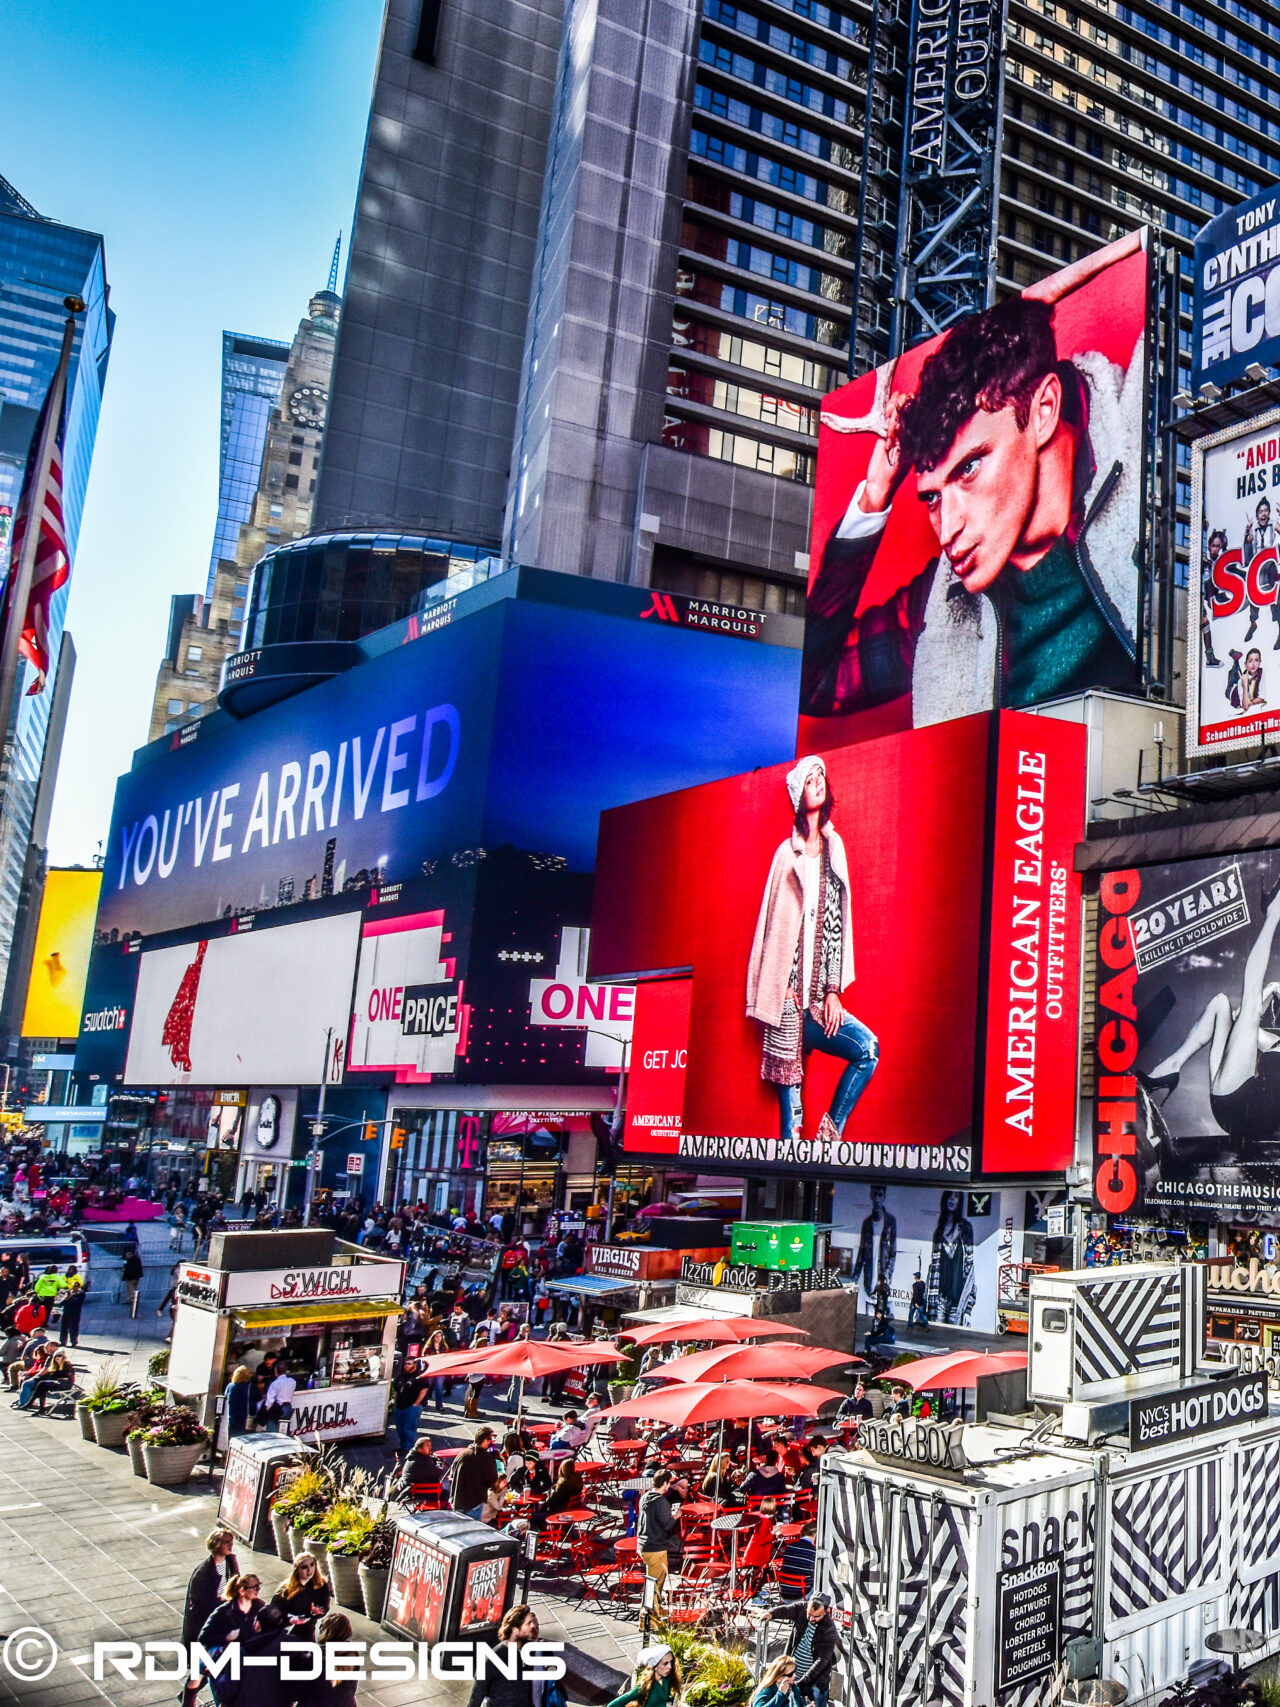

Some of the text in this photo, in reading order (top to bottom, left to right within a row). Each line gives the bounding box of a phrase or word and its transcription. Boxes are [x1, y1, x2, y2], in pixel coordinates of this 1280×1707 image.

[1236, 199, 1277, 236] TONY
[1201, 289, 1232, 371] THE
[1237, 468, 1267, 499] HAS
[423, 599, 457, 621] MARRIOTT
[688, 601, 767, 624] MARRIOTT
[421, 613, 452, 634] MARQUIS
[687, 612, 758, 636] MARQUIS
[230, 651, 262, 667] ARRIOTT
[228, 665, 254, 680] ARQUIS
[118, 703, 461, 890] YOU'VE ARRIVED
[1134, 874, 1238, 945] 20 YEARS
[1005, 751, 1046, 1136] AMERICAN EAGLE
[1046, 864, 1068, 1019] OUTFITTERS
[1177, 937, 1184, 948] IT
[368, 987, 403, 1022] ONE
[403, 996, 457, 1034] PRICE
[541, 984, 635, 1021] ONE
[83, 1005, 119, 1032] swatch
[1096, 869, 1142, 1214] CHICAGO
[644, 1050, 668, 1070] GET
[632, 1115, 673, 1127] AMERICAN
[680, 1135, 970, 1172] AMERICAN EAGLE OUTFITTERS
[591, 1246, 641, 1271] VIRGIL'S
[270, 1281, 361, 1299] Delicatessen
[768, 1267, 842, 1293] DRINK
[1248, 1309, 1276, 1318] PASTRIES
[1139, 1404, 1170, 1426] NYC's
[1171, 1381, 1264, 1432] HOT DOGS
[1140, 1421, 1169, 1440] best
[1001, 1492, 1095, 1570] snack
[470, 1559, 506, 1586] JERSEY
[1001, 1559, 1060, 1588] SnackBox
[472, 1579, 497, 1600] BOYS
[1013, 1582, 1047, 1603] HOTDOGS
[1009, 1595, 1051, 1619] BRATWURST
[1014, 1611, 1046, 1631] CHORIZO
[1005, 1622, 1054, 1649] LOBSTER ROLL
[1013, 1639, 1046, 1661] PRETZELS
[1007, 1651, 1051, 1677] DOUGHNUTS
